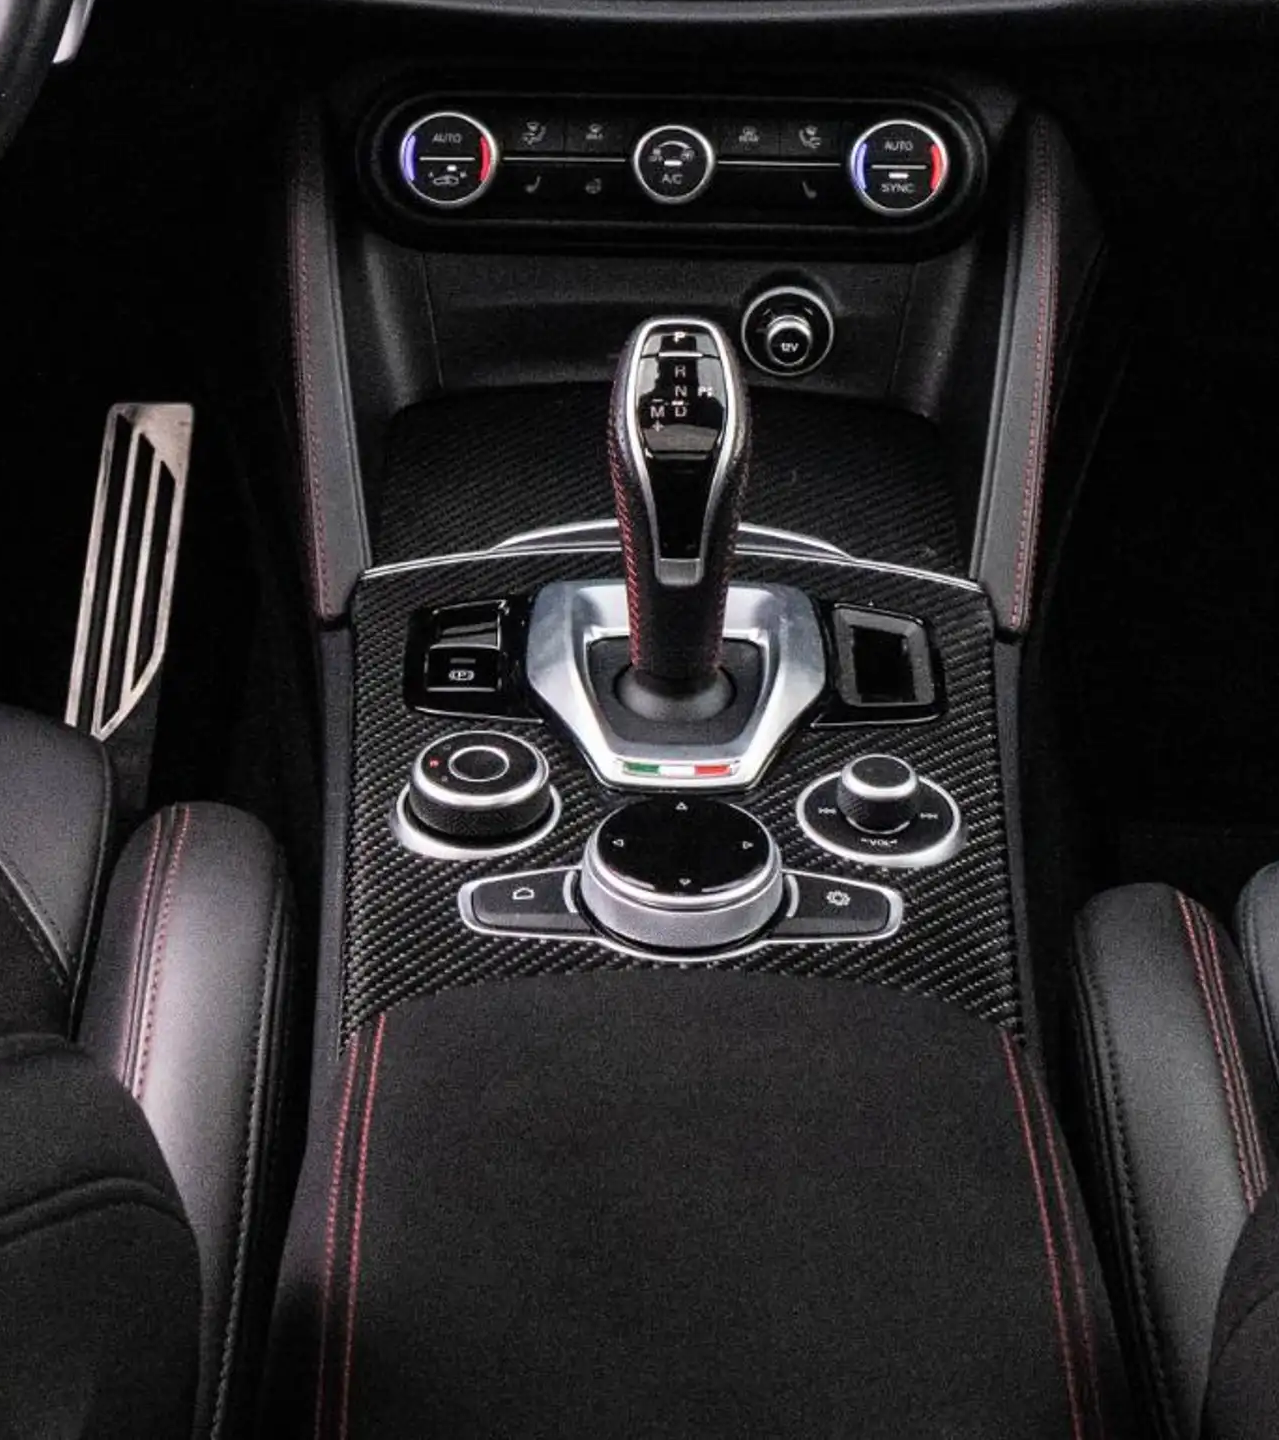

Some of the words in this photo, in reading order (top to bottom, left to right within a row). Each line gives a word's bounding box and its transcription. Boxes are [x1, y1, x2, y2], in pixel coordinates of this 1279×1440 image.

[432, 133, 463, 144] AUTO
[884, 140, 914, 152] AUTO
[661, 173, 684, 185] A/C
[881, 183, 915, 194] SYNC
[780, 342, 799, 353] 12V
[675, 385, 688, 398] N
[650, 407, 665, 418] M
